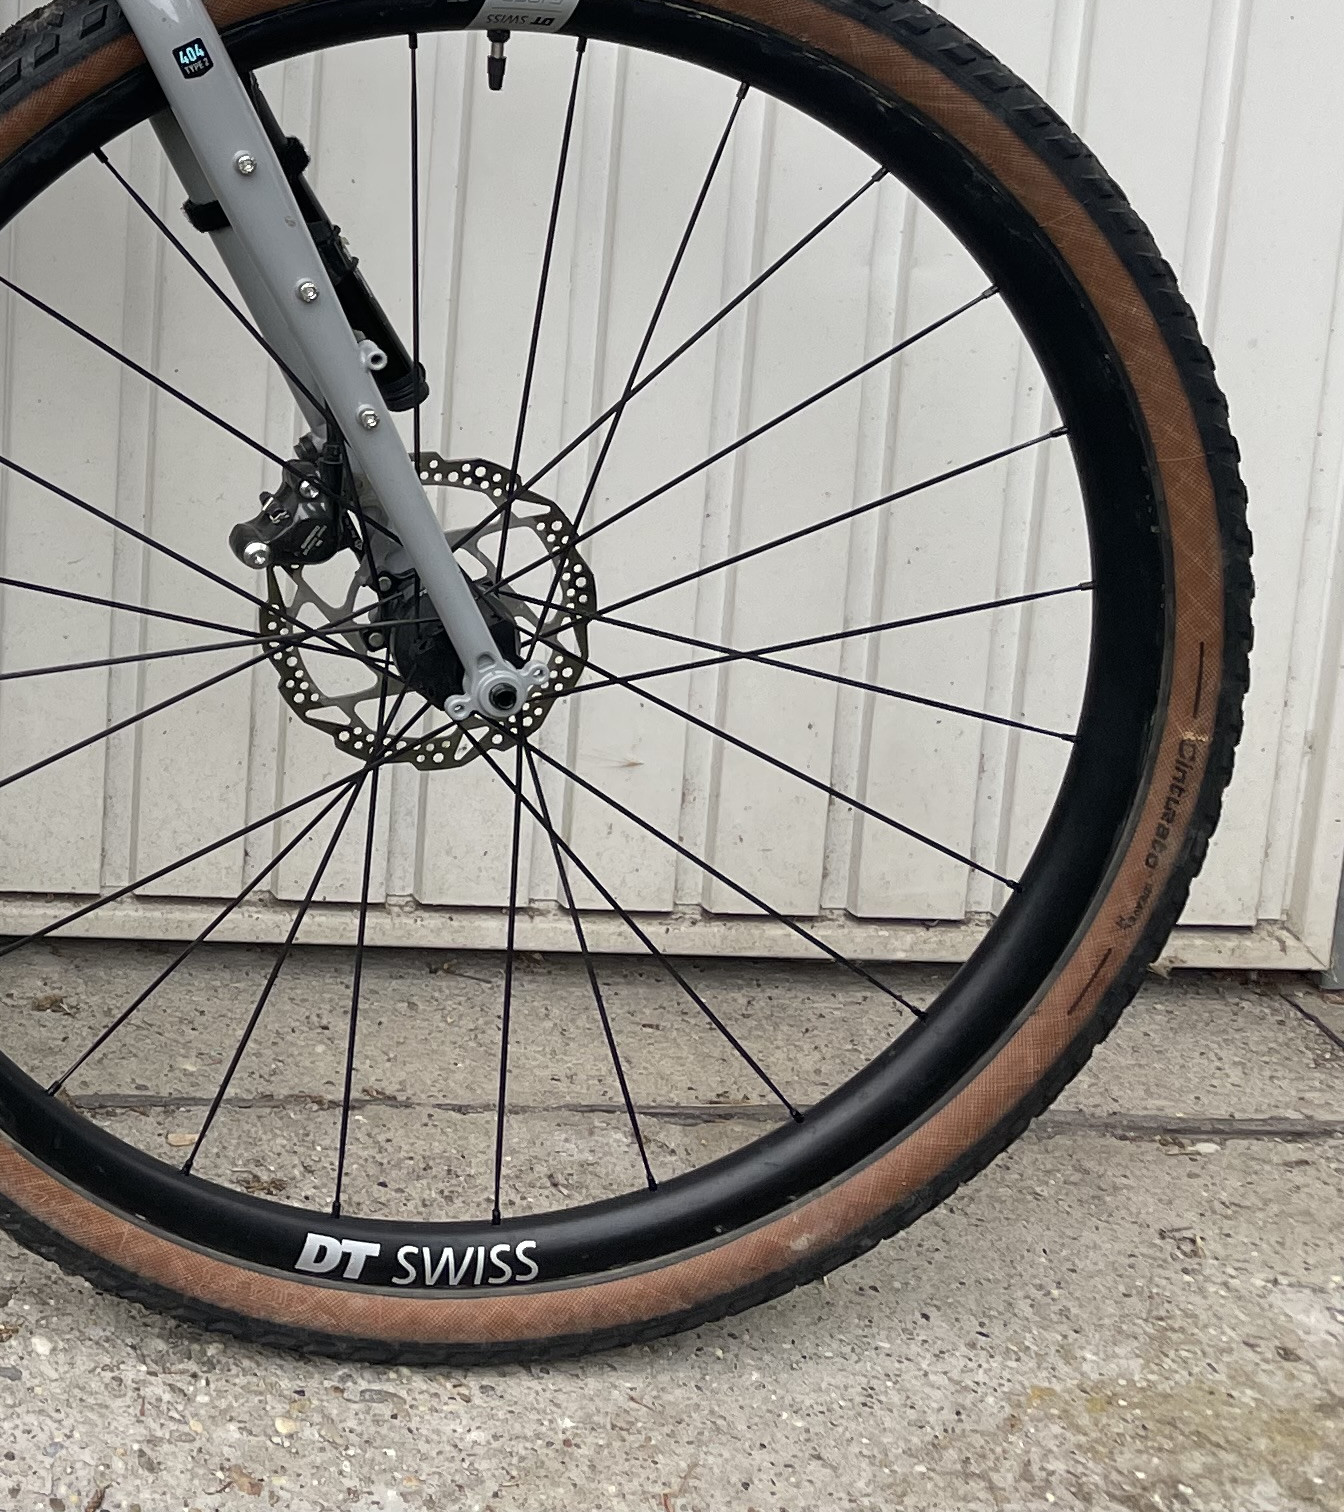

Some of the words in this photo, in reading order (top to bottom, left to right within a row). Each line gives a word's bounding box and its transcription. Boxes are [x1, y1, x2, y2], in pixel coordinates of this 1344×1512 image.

[486, 13, 528, 25] SWISS
[530, 17, 555, 26] DT
[179, 43, 205, 64] 404
[184, 60, 204, 75] TYPE
[295, 1232, 381, 1280] DT
[391, 1240, 540, 1286] SWISS
